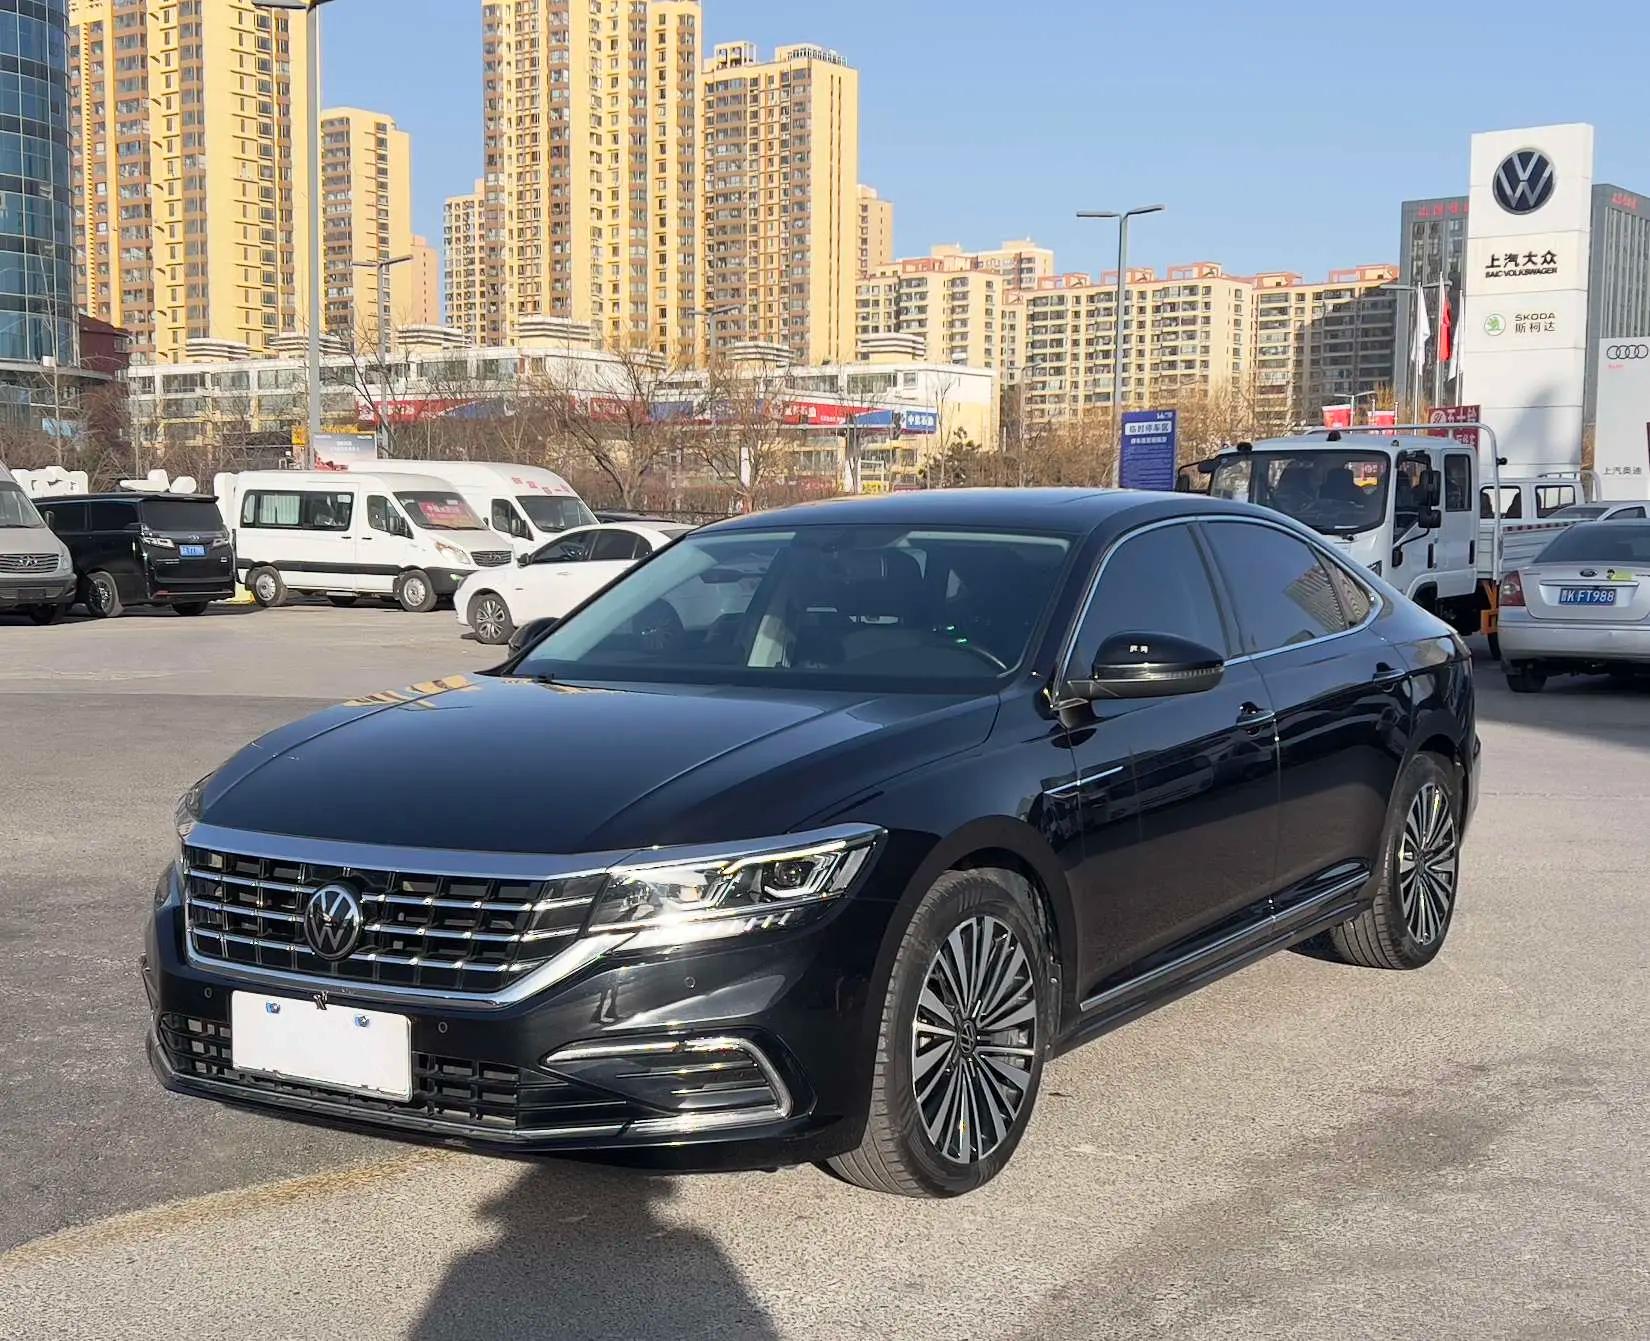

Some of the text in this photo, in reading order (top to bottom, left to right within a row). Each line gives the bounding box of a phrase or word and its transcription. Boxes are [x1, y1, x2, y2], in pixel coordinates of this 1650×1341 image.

[1485, 250, 1557, 268] 上汽大众
[1485, 267, 1557, 278] SAIC VOLKSWAGEN
[1515, 313, 1555, 321] SKODA
[1515, 321, 1557, 333] 斯柯达
